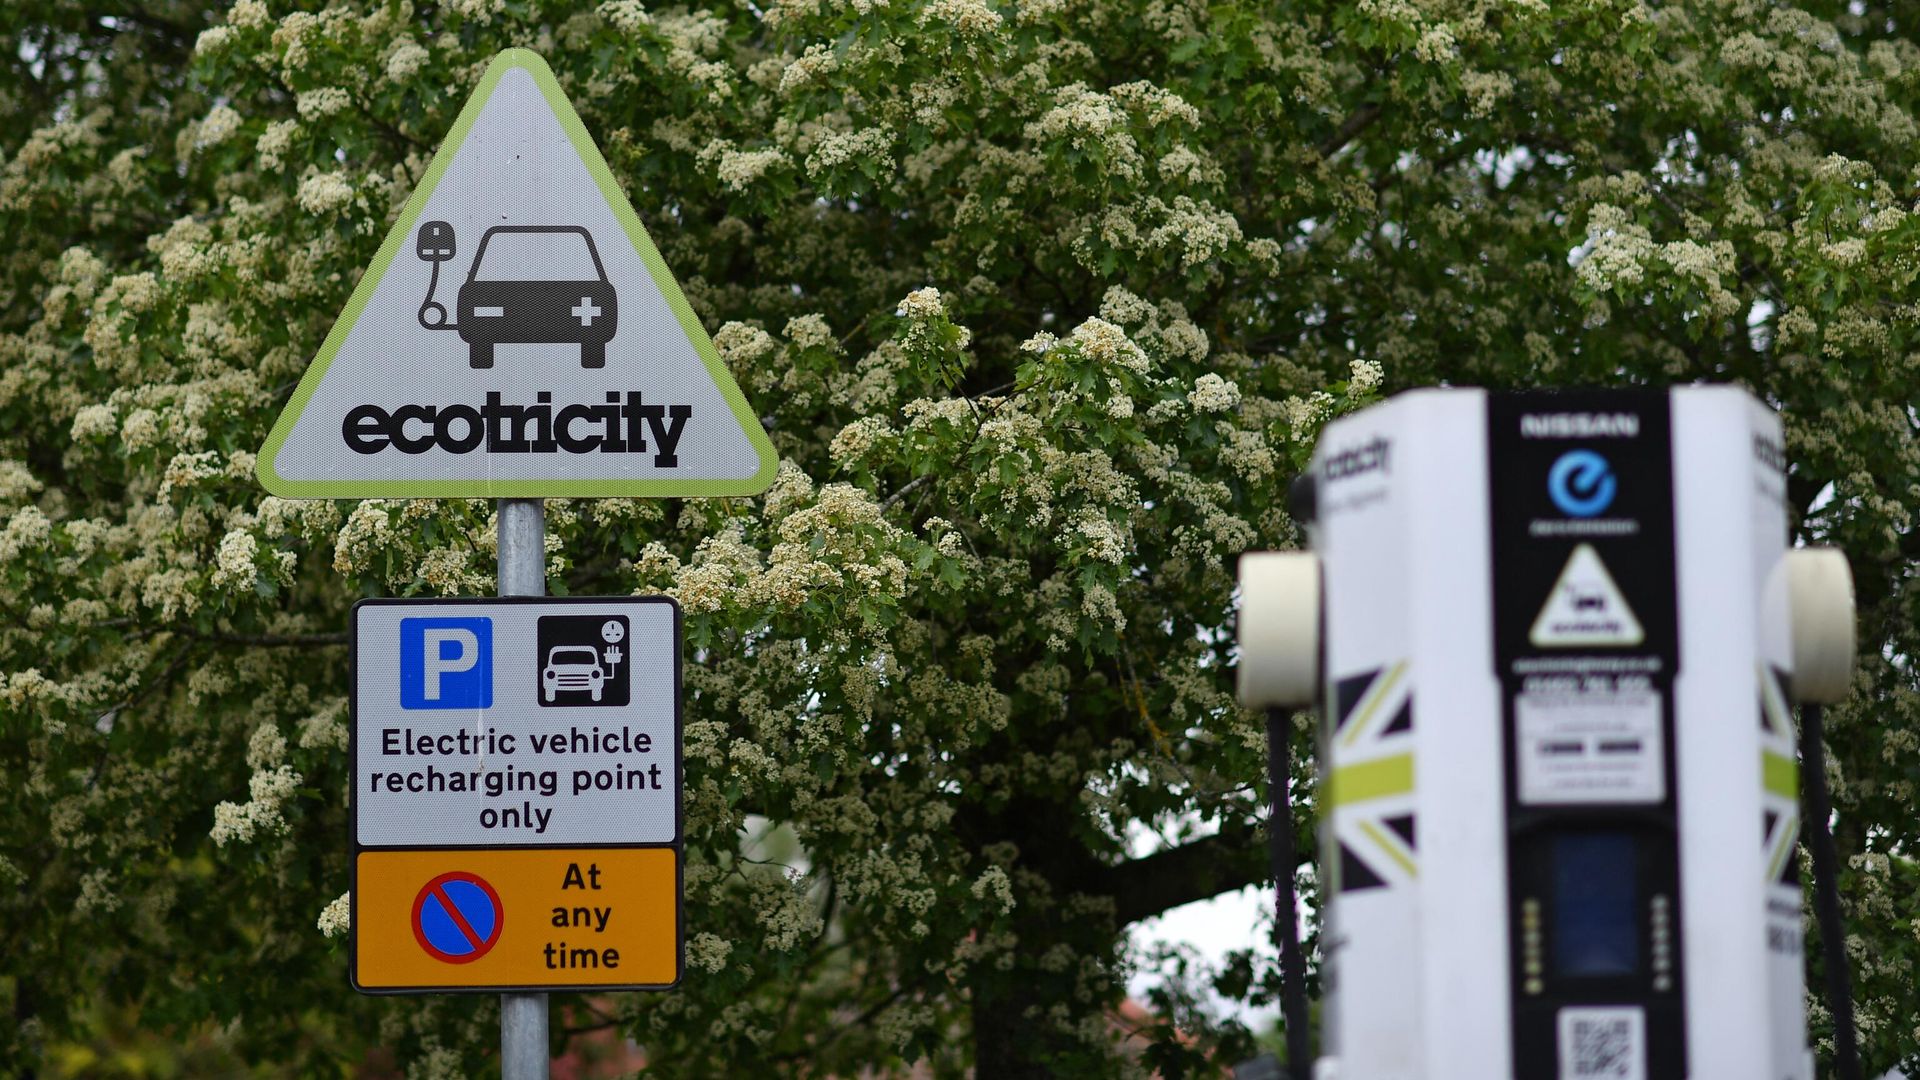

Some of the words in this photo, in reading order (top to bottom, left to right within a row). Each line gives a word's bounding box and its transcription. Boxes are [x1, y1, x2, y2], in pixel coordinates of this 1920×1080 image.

[342, 391, 692, 468] ecotricity
[1521, 413, 1640, 437] NISSAN
[424, 628, 478, 700] P
[382, 728, 516, 756] Electric
[529, 726, 652, 754] vehicle
[370, 765, 558, 797] recharging
[572, 763, 662, 796] point
[479, 801, 552, 833] only
[562, 863, 602, 890] At
[551, 906, 612, 932] any
[543, 942, 620, 969] time
